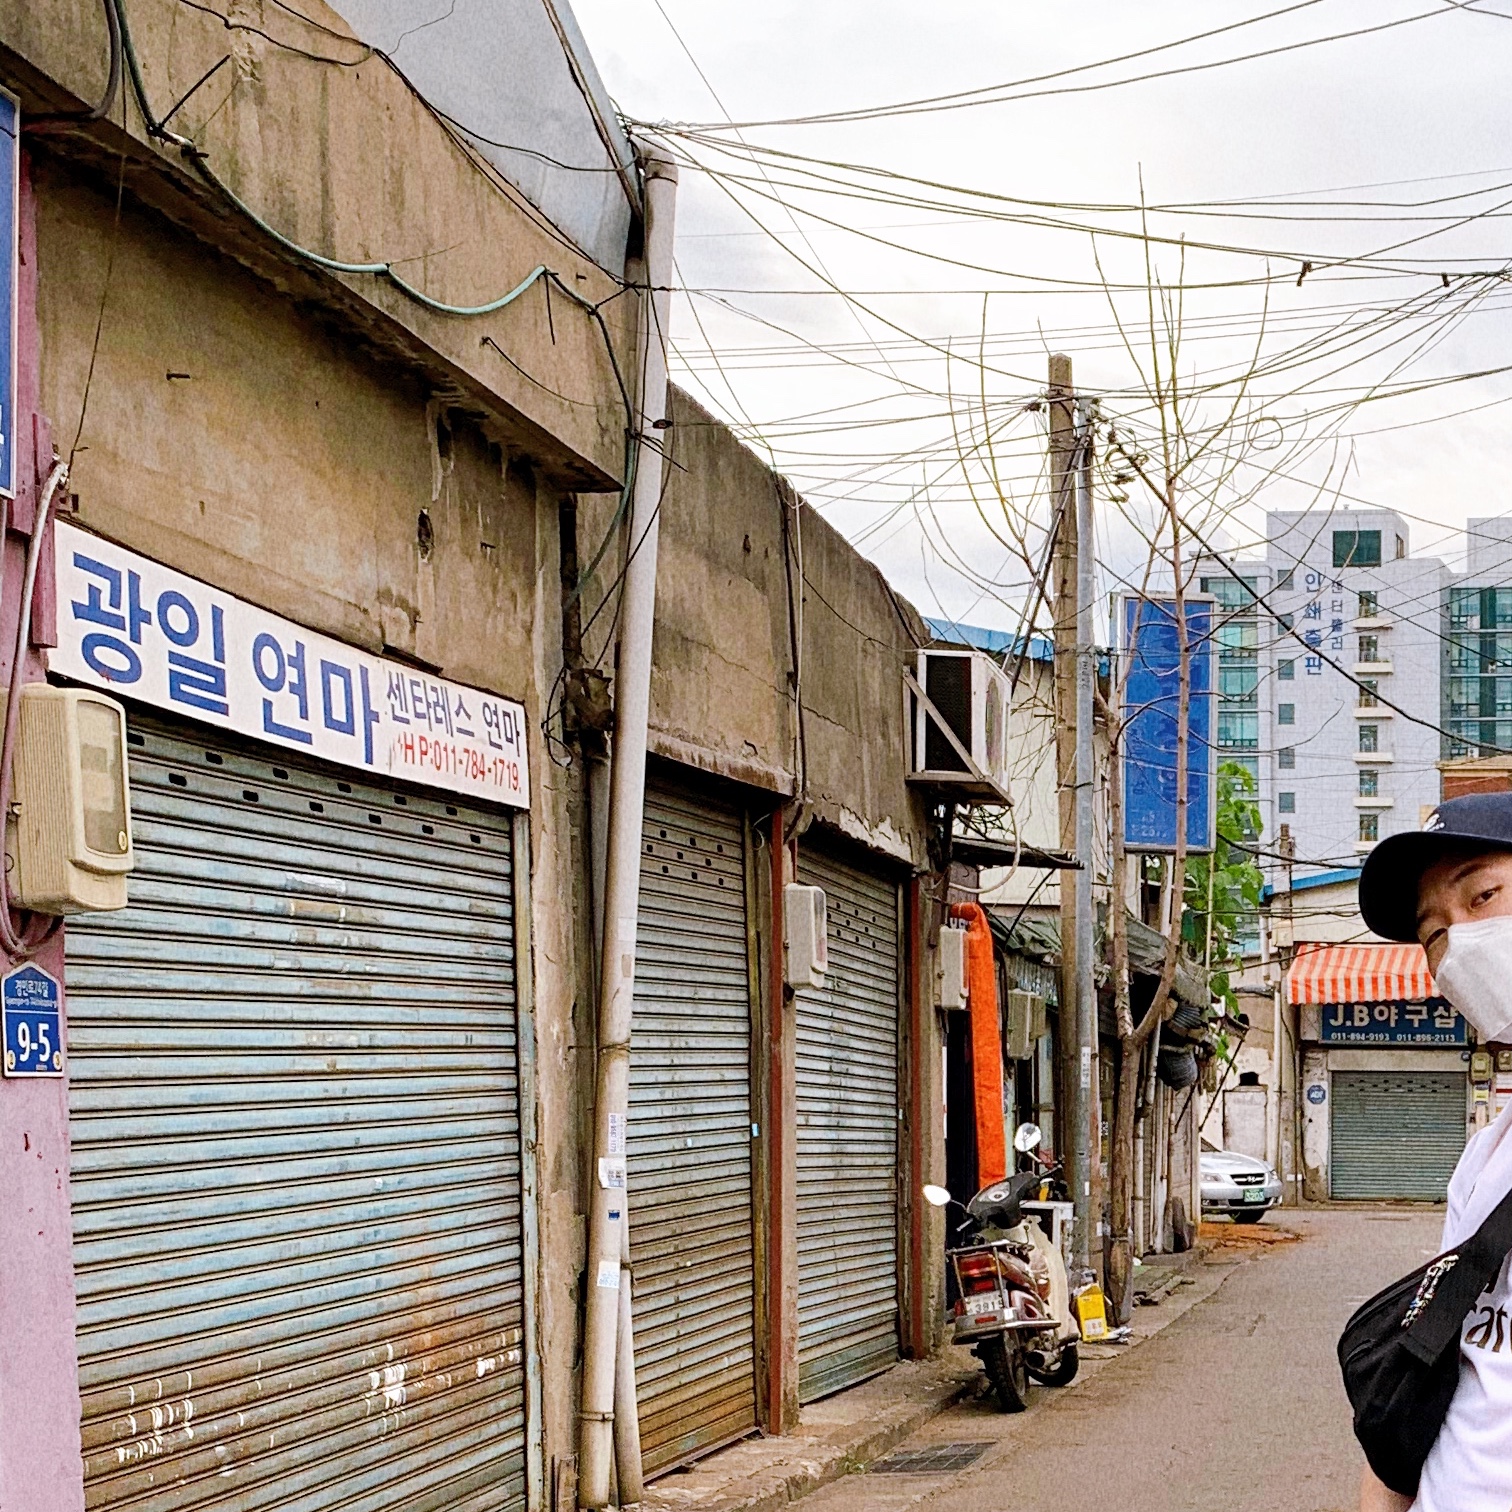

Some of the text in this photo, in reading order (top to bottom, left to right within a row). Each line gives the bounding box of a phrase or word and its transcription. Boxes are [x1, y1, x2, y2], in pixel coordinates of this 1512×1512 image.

[71, 552, 379, 765] 광일 연마
[387, 670, 521, 758] 센타레스 연마
[18, 1021, 51, 1063] 9-5
